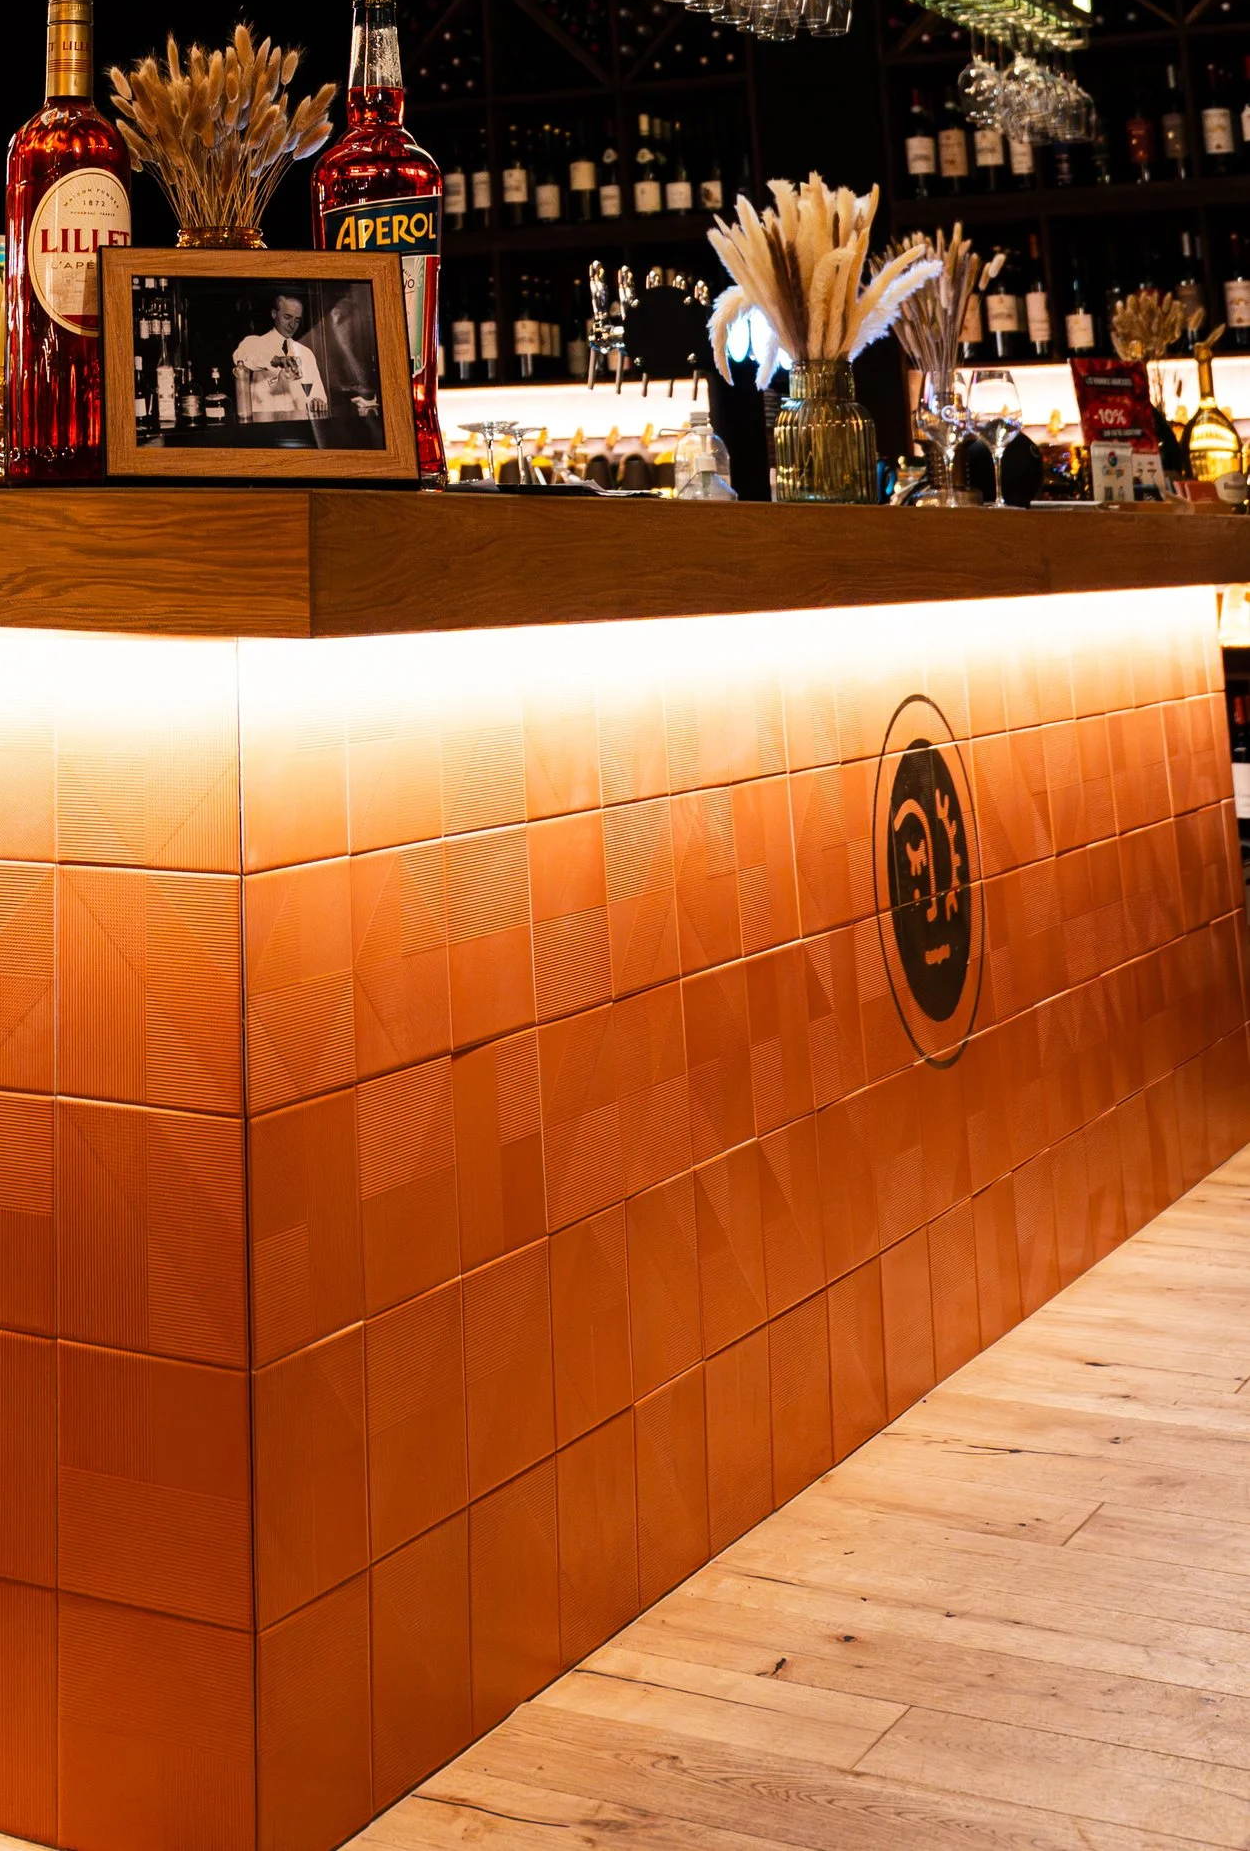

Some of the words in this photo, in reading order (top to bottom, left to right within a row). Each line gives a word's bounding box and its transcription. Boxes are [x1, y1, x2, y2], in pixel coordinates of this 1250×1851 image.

[81, 200, 106, 208] 1872
[335, 211, 437, 251] APEROL
[1093, 408, 1127, 425] -10%
